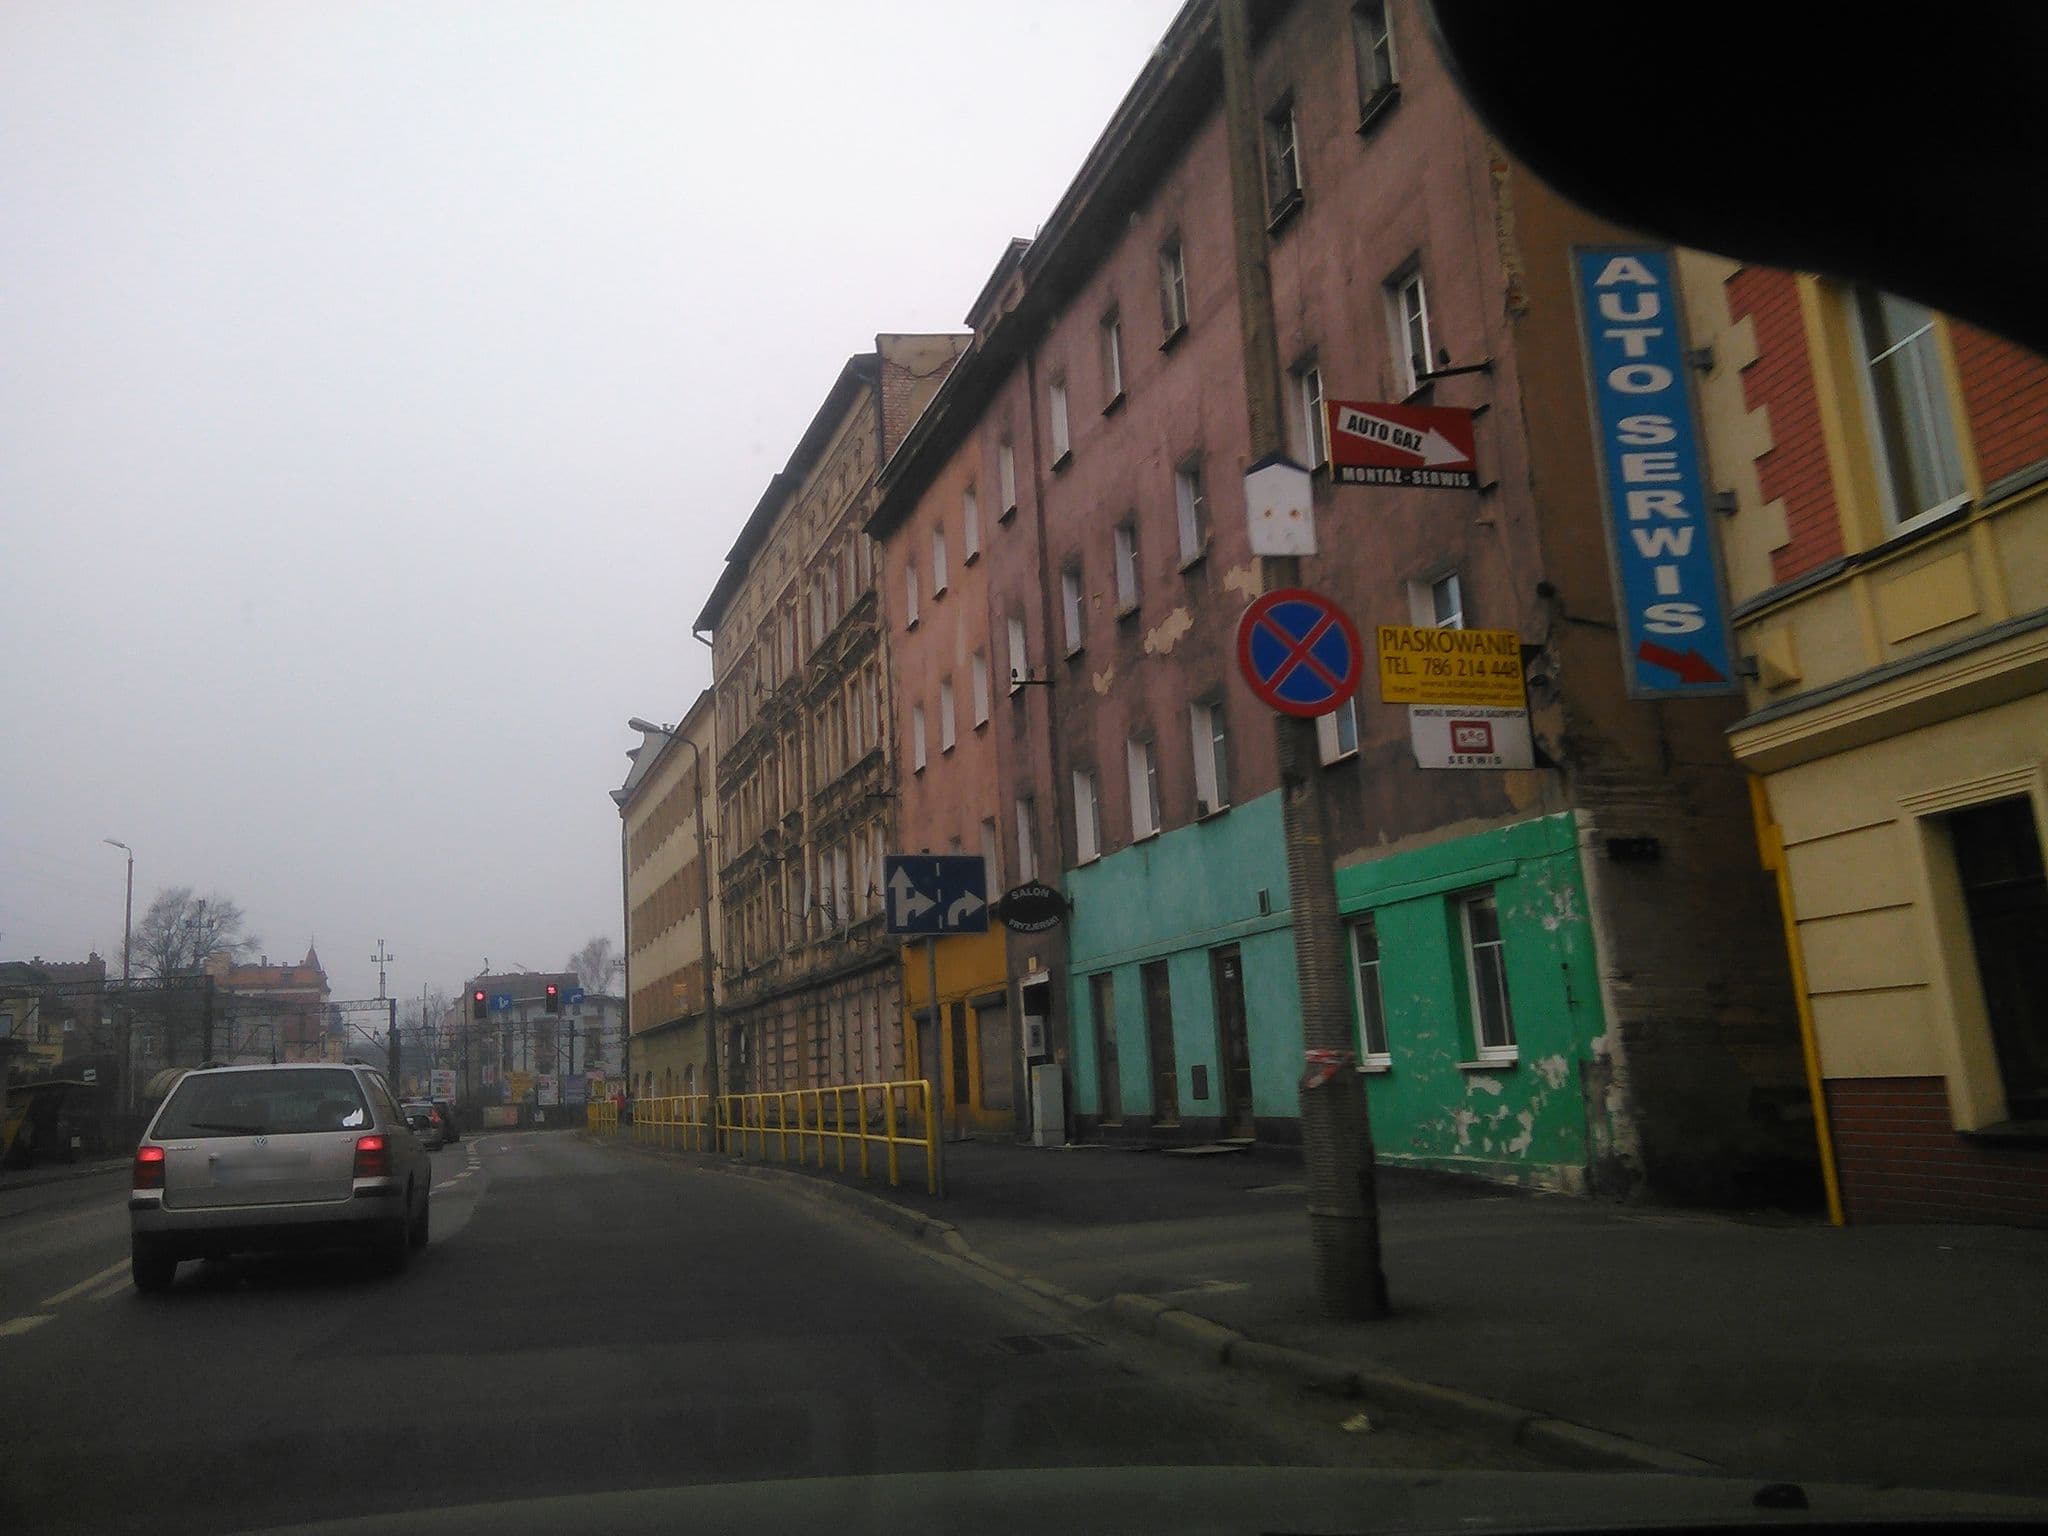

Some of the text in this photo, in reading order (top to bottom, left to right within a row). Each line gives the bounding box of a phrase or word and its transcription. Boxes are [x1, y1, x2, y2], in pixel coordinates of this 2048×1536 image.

[1348, 414, 1422, 451] AUTO GAZ
[1595, 256, 1705, 635] AUTO SERWIS
[1382, 628, 1518, 656] PIASKOWANIE
[1423, 656, 1451, 676] 786
[1457, 658, 1486, 677] 214
[1448, 755, 1502, 765] SERWIS
[1011, 887, 1050, 900] SALON
